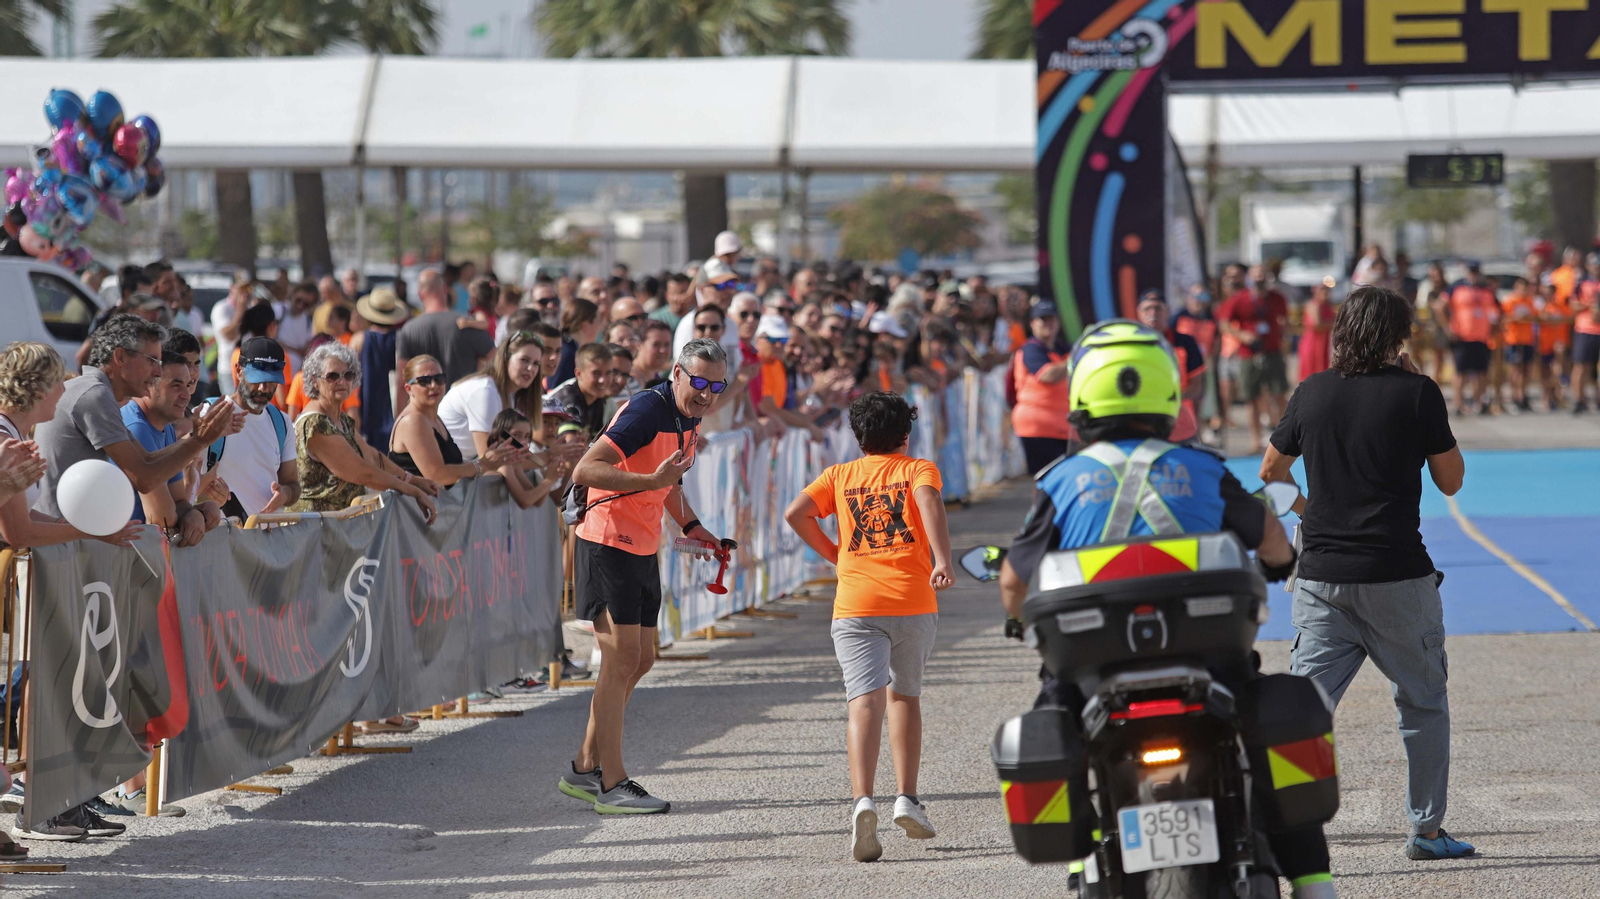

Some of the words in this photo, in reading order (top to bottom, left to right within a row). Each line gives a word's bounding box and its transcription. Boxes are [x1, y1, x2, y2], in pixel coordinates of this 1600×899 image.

[1067, 36, 1115, 52] Puerto
[1195, 0, 1600, 69] MET
[1046, 51, 1137, 74] Algeciras
[844, 486, 871, 497] CARRERA
[1143, 805, 1202, 837] 3591
[1148, 832, 1202, 863] LTS
